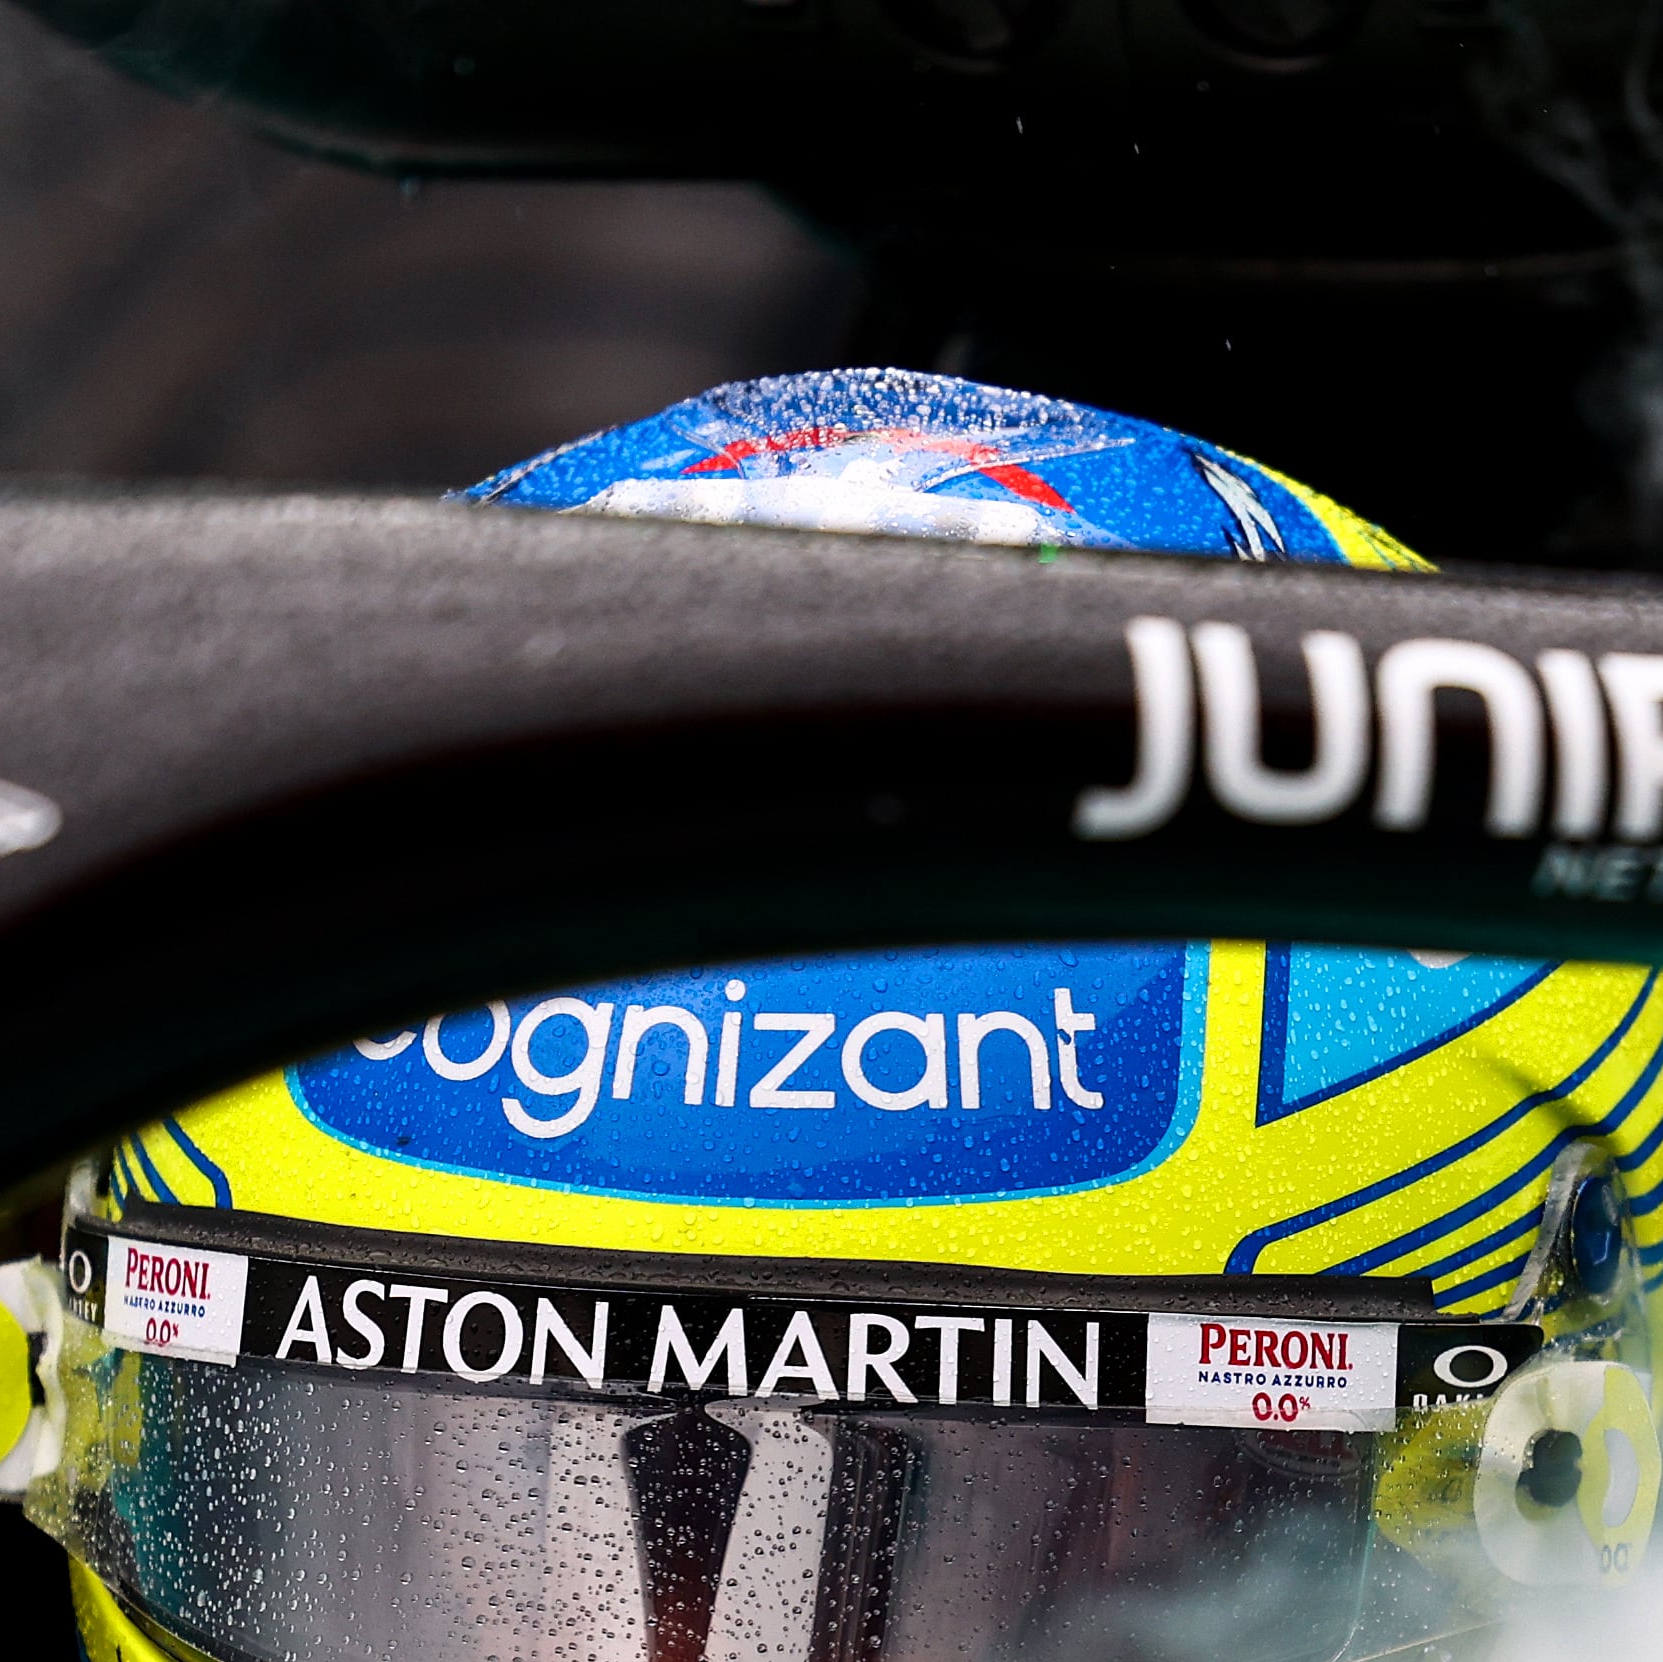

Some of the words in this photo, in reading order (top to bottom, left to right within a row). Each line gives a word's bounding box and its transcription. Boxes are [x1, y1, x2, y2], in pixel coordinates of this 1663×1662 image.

[158, 1299, 206, 1318] AZZURRO
[275, 1275, 609, 1389] ASTON
[647, 1305, 1100, 1410] MARTIN
[1198, 1371, 1267, 1386] NASTRO
[1271, 1374, 1348, 1389] AZZURRO
[1251, 1391, 1311, 1422] 0.0%
